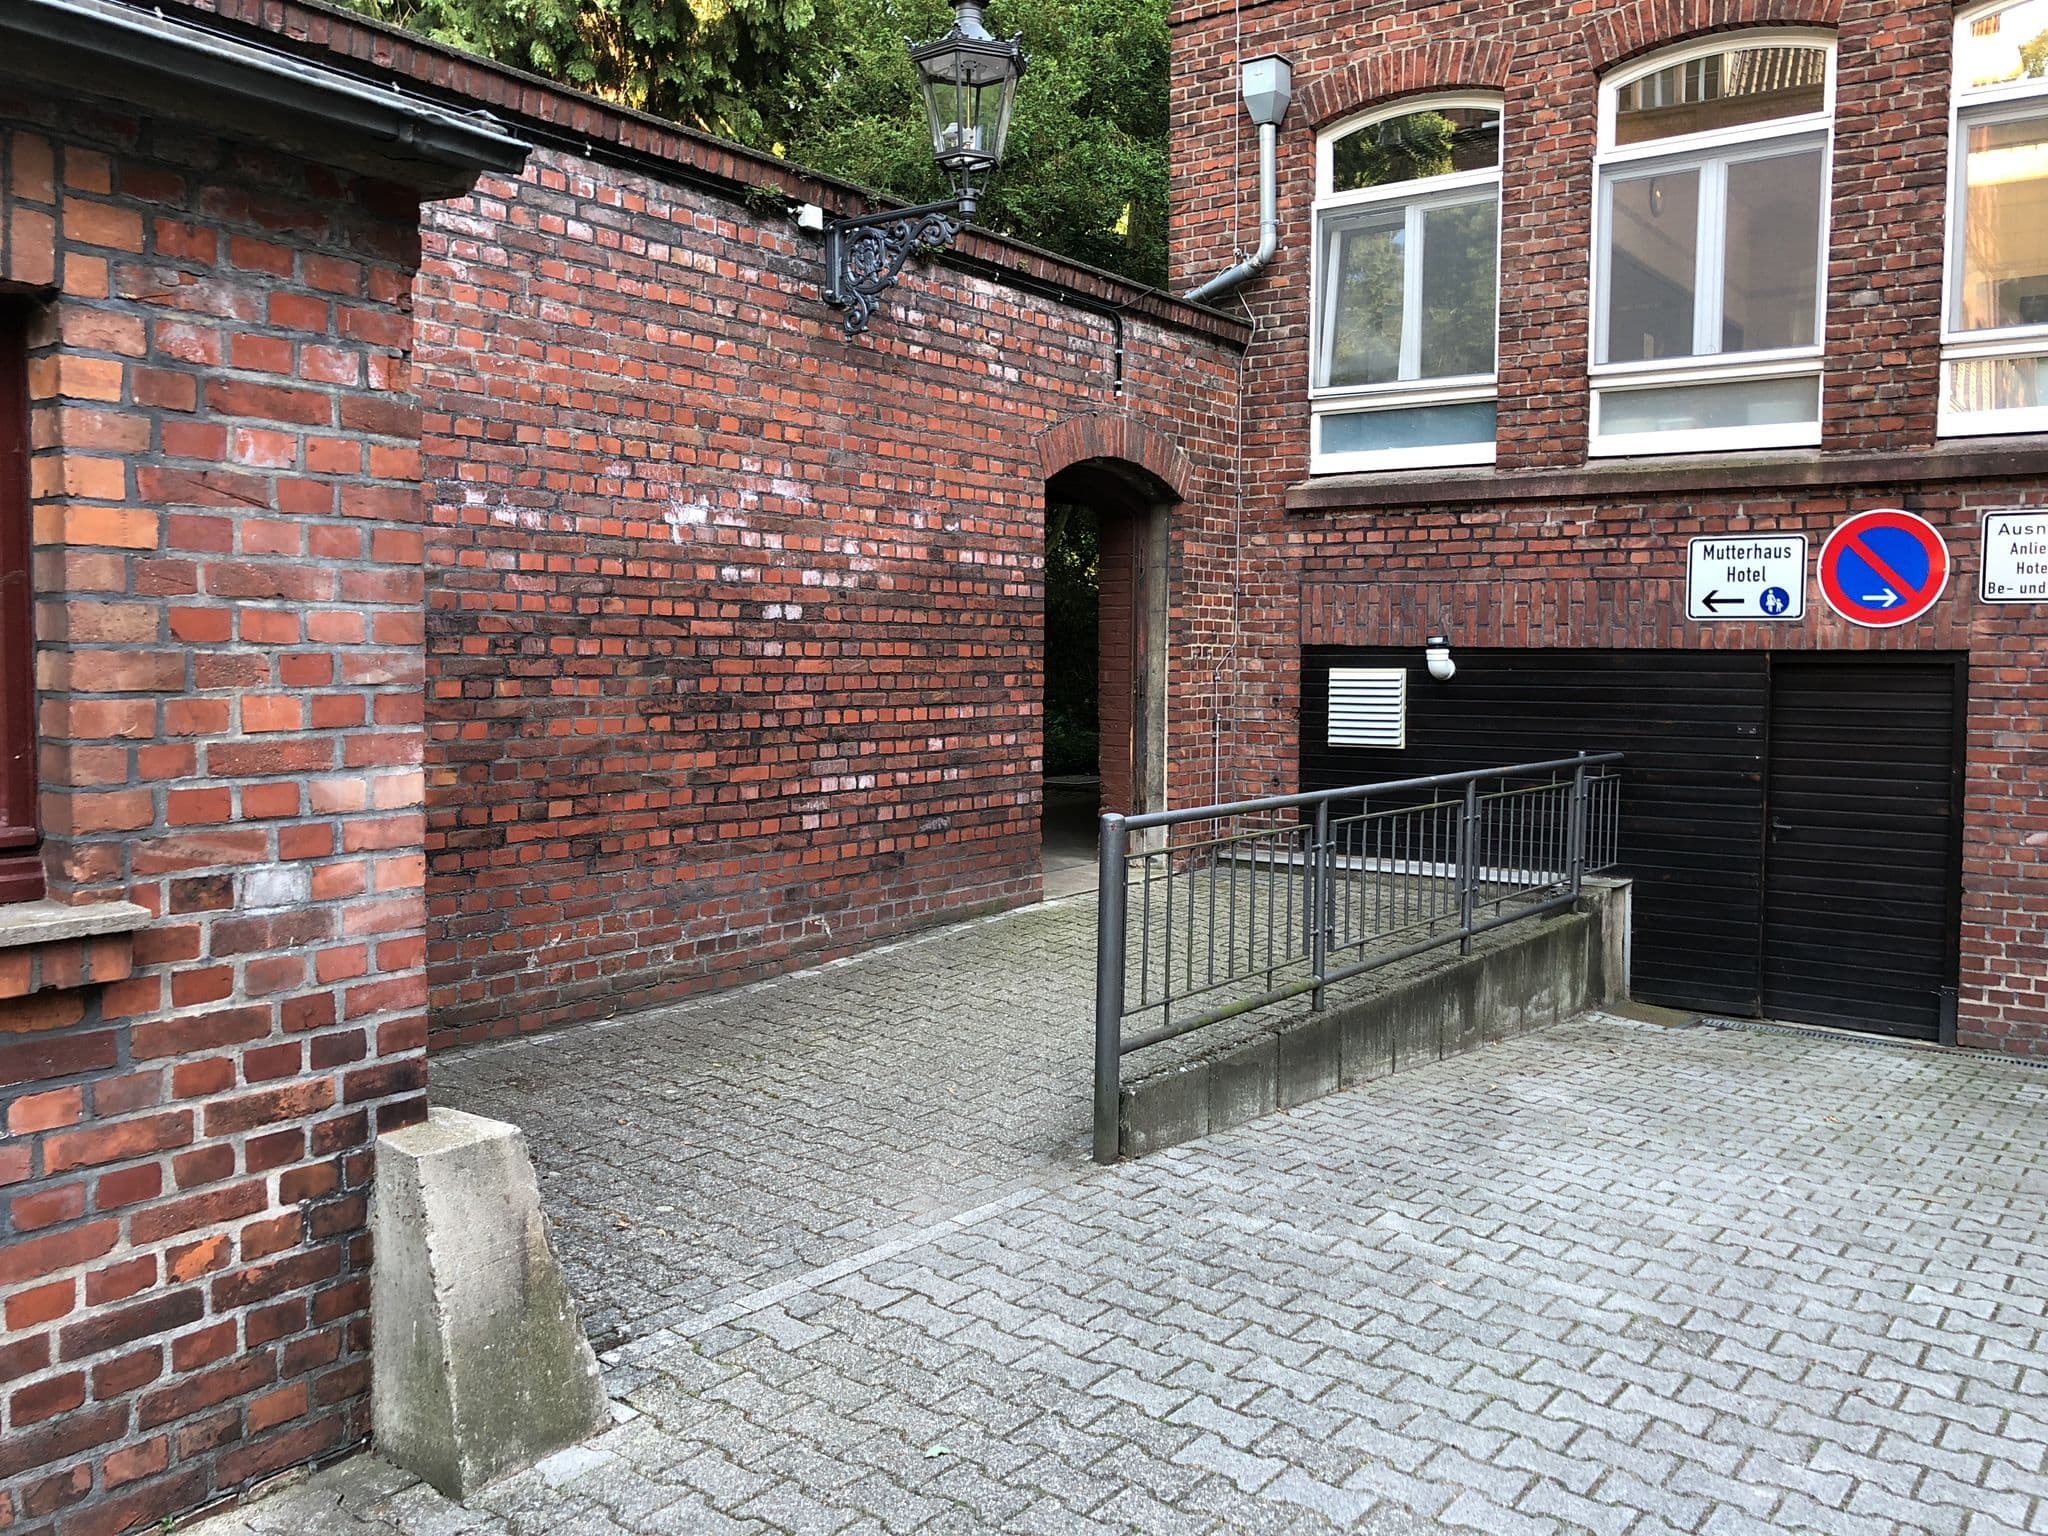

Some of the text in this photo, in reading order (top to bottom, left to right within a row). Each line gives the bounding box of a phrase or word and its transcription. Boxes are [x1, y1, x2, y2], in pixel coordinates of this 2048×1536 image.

[1998, 523, 2046, 535] Ausn
[1703, 544, 1791, 561] Mutterhaus
[2010, 542, 2047, 555] Anlie
[1727, 566, 1766, 582] Hotel
[2016, 562, 2048, 575] Hote
[1988, 581, 2046, 594] Be- und
